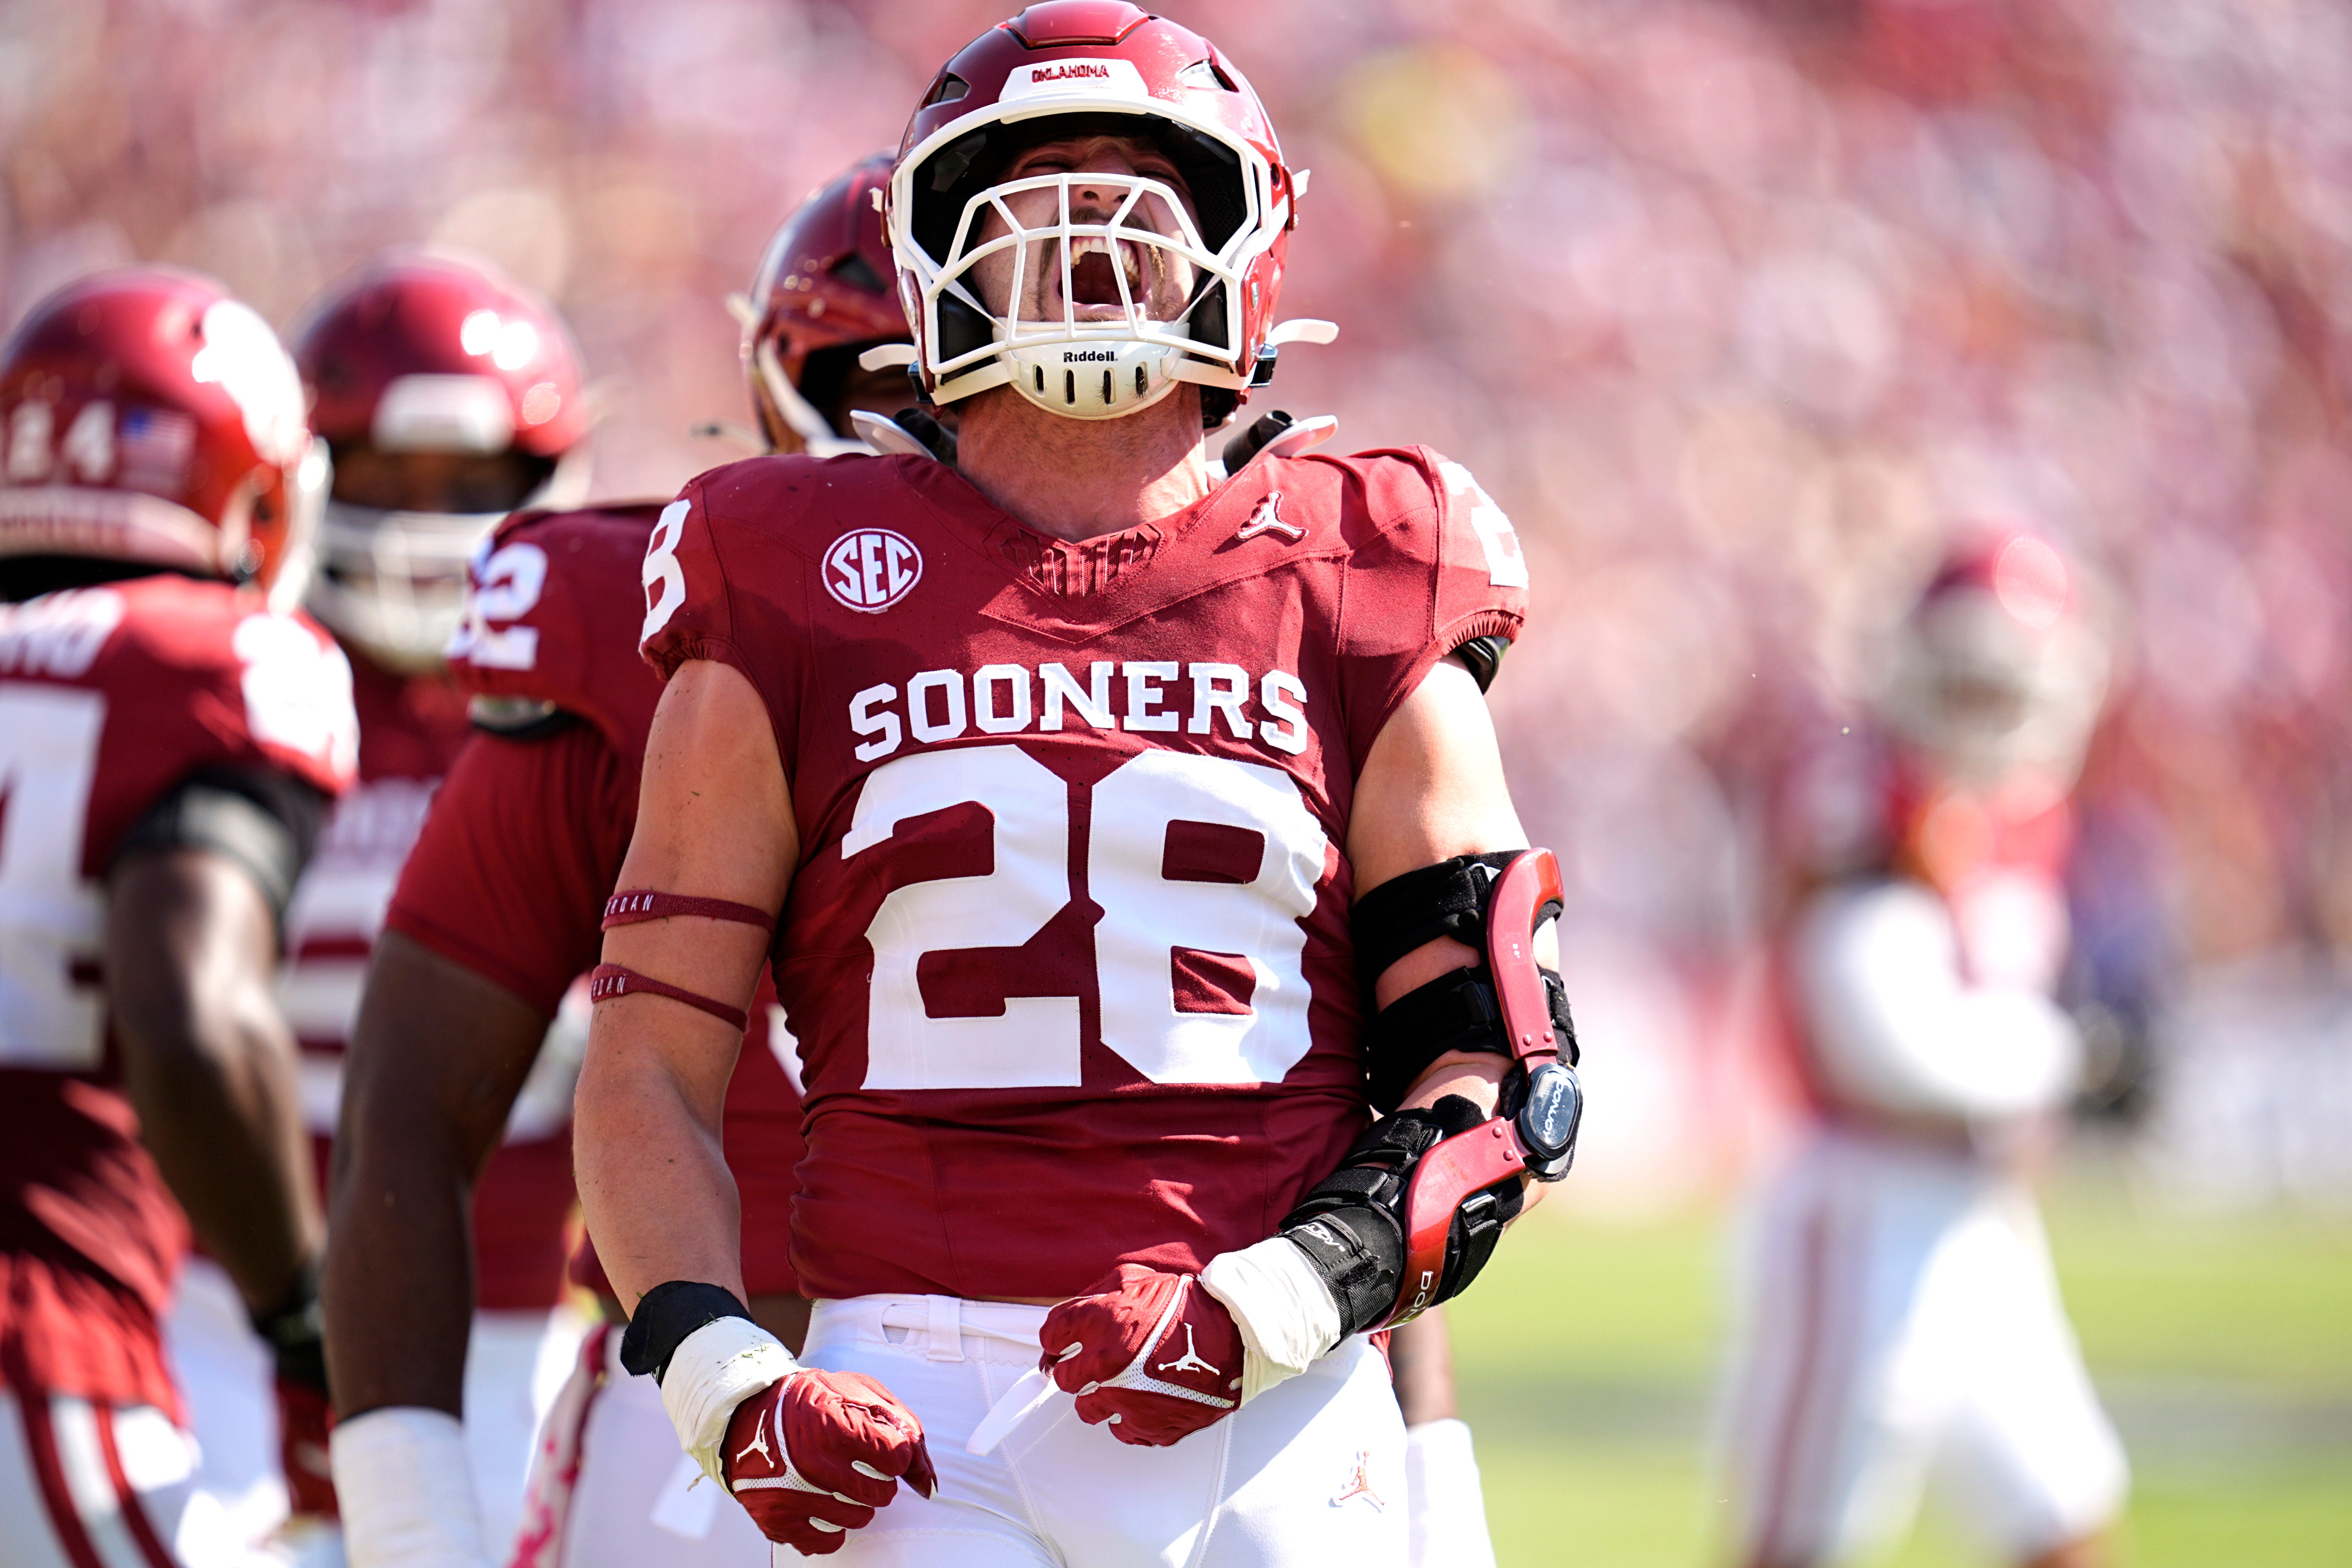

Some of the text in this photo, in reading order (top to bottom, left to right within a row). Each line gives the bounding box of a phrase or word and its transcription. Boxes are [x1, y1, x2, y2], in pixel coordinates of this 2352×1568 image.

[1032, 64, 1109, 83] OKLAHOMA
[830, 534, 913, 604] SEC
[849, 662, 1309, 763] SOONERS
[840, 743, 1327, 1090] 28
[1541, 1078, 1565, 1143] DONJOY
